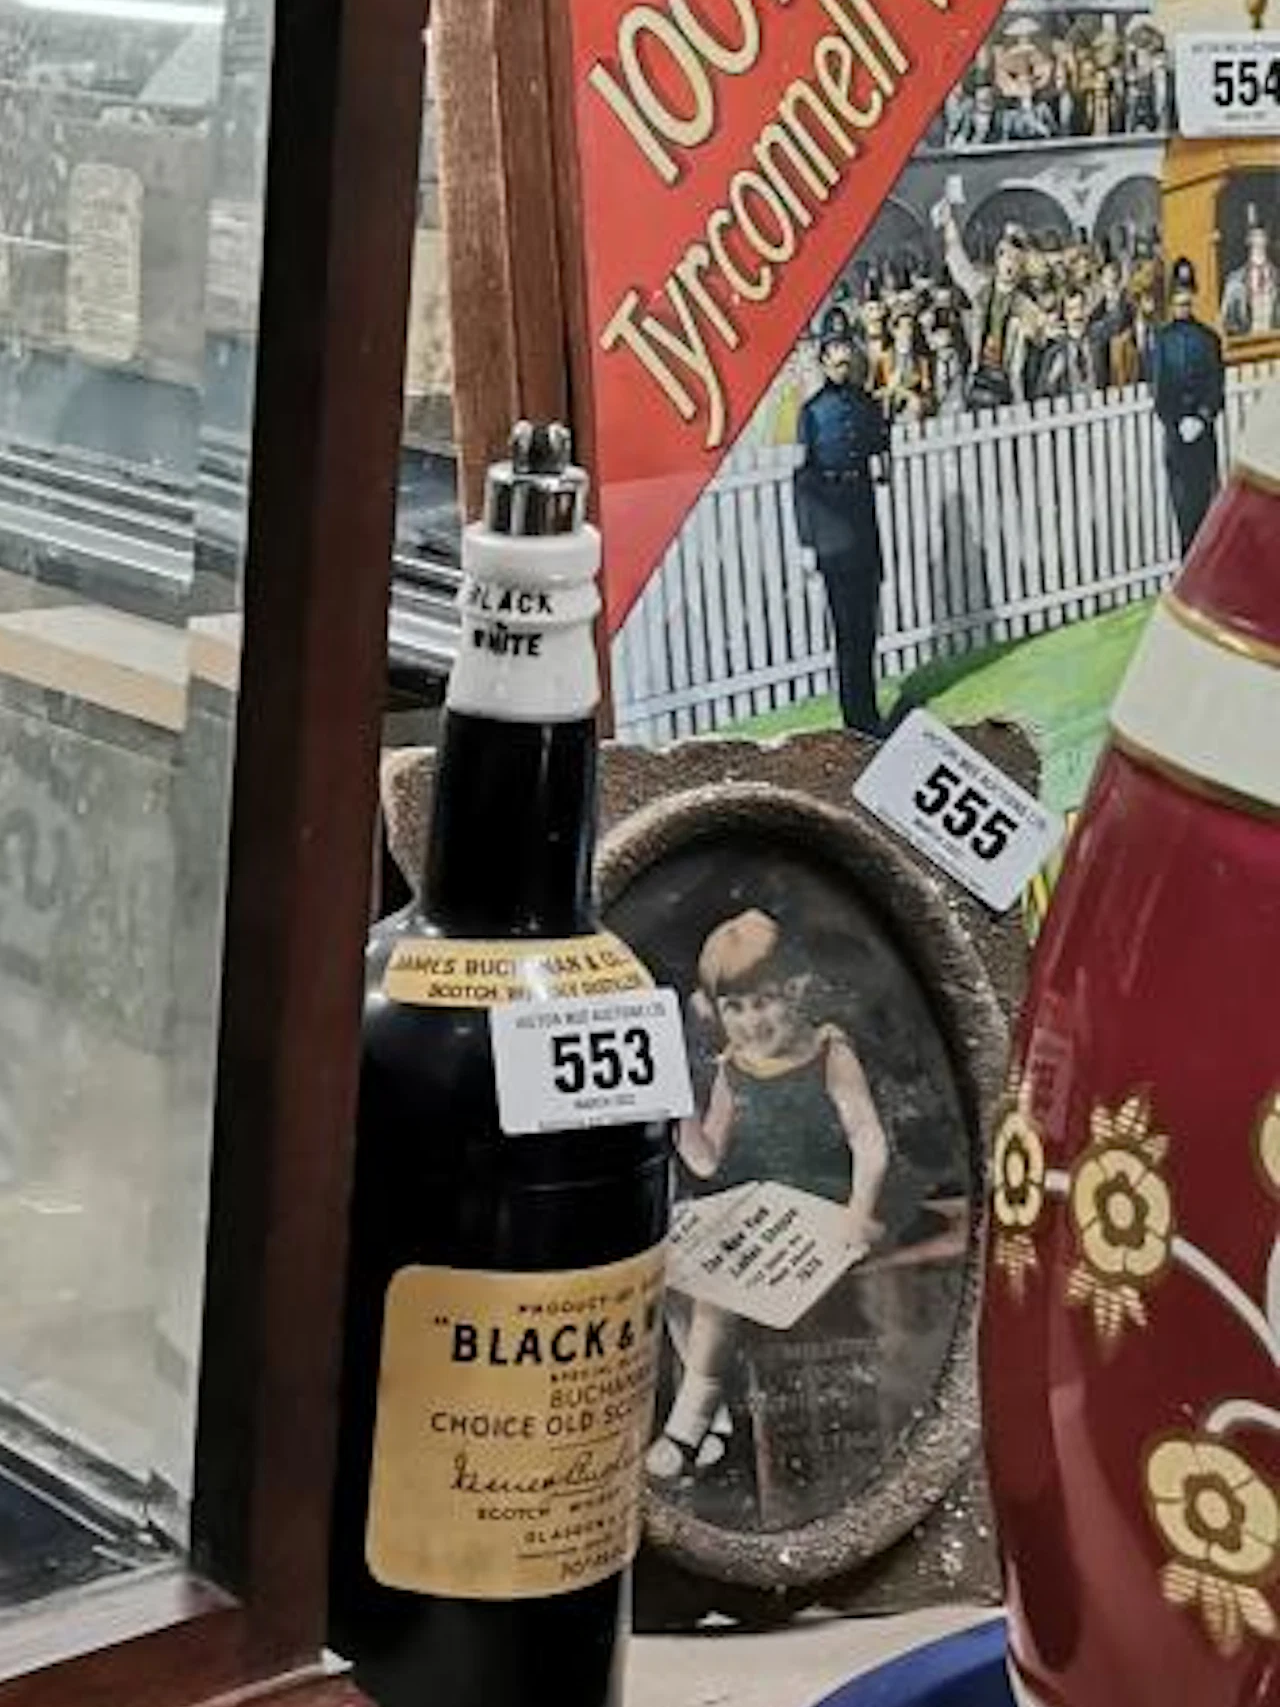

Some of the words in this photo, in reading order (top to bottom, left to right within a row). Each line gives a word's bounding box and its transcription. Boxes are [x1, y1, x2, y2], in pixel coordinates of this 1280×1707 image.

[1214, 60, 1280, 106] 554
[914, 764, 1018, 860] 555
[427, 983, 498, 1002] SCOTCH
[551, 1028, 654, 1093] 553
[431, 1410, 539, 1439] CHOICE
[546, 1410, 594, 1437] OLD
